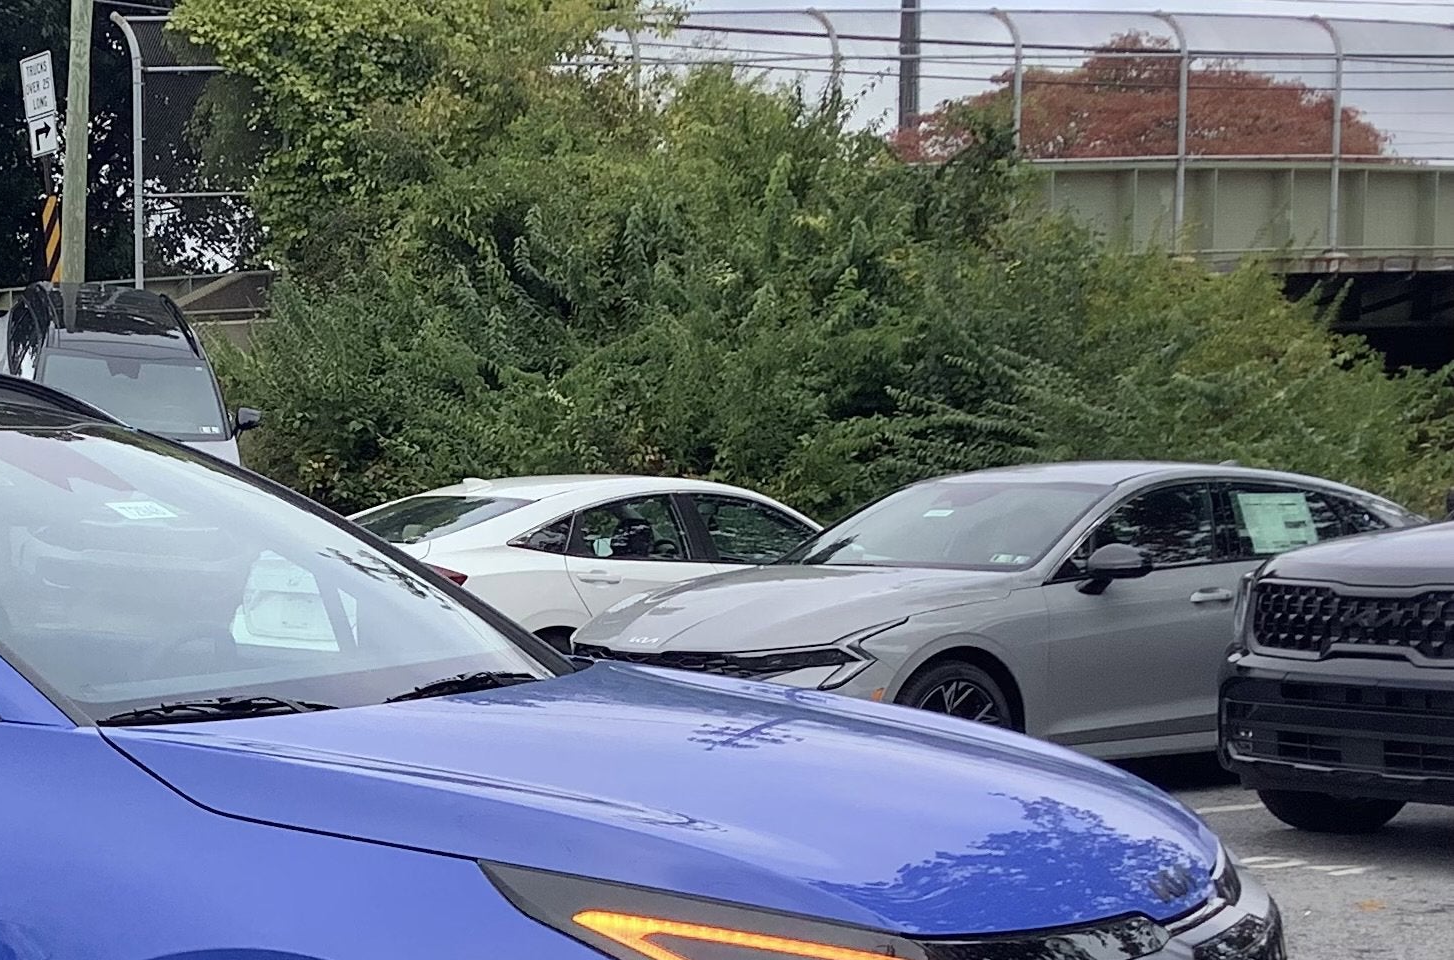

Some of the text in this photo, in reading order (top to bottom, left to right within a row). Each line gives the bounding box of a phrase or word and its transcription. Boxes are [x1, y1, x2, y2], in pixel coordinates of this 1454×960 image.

[25, 60, 48, 77] TRUCKS
[25, 80, 40, 96] OVER
[32, 95, 48, 111] LONG
